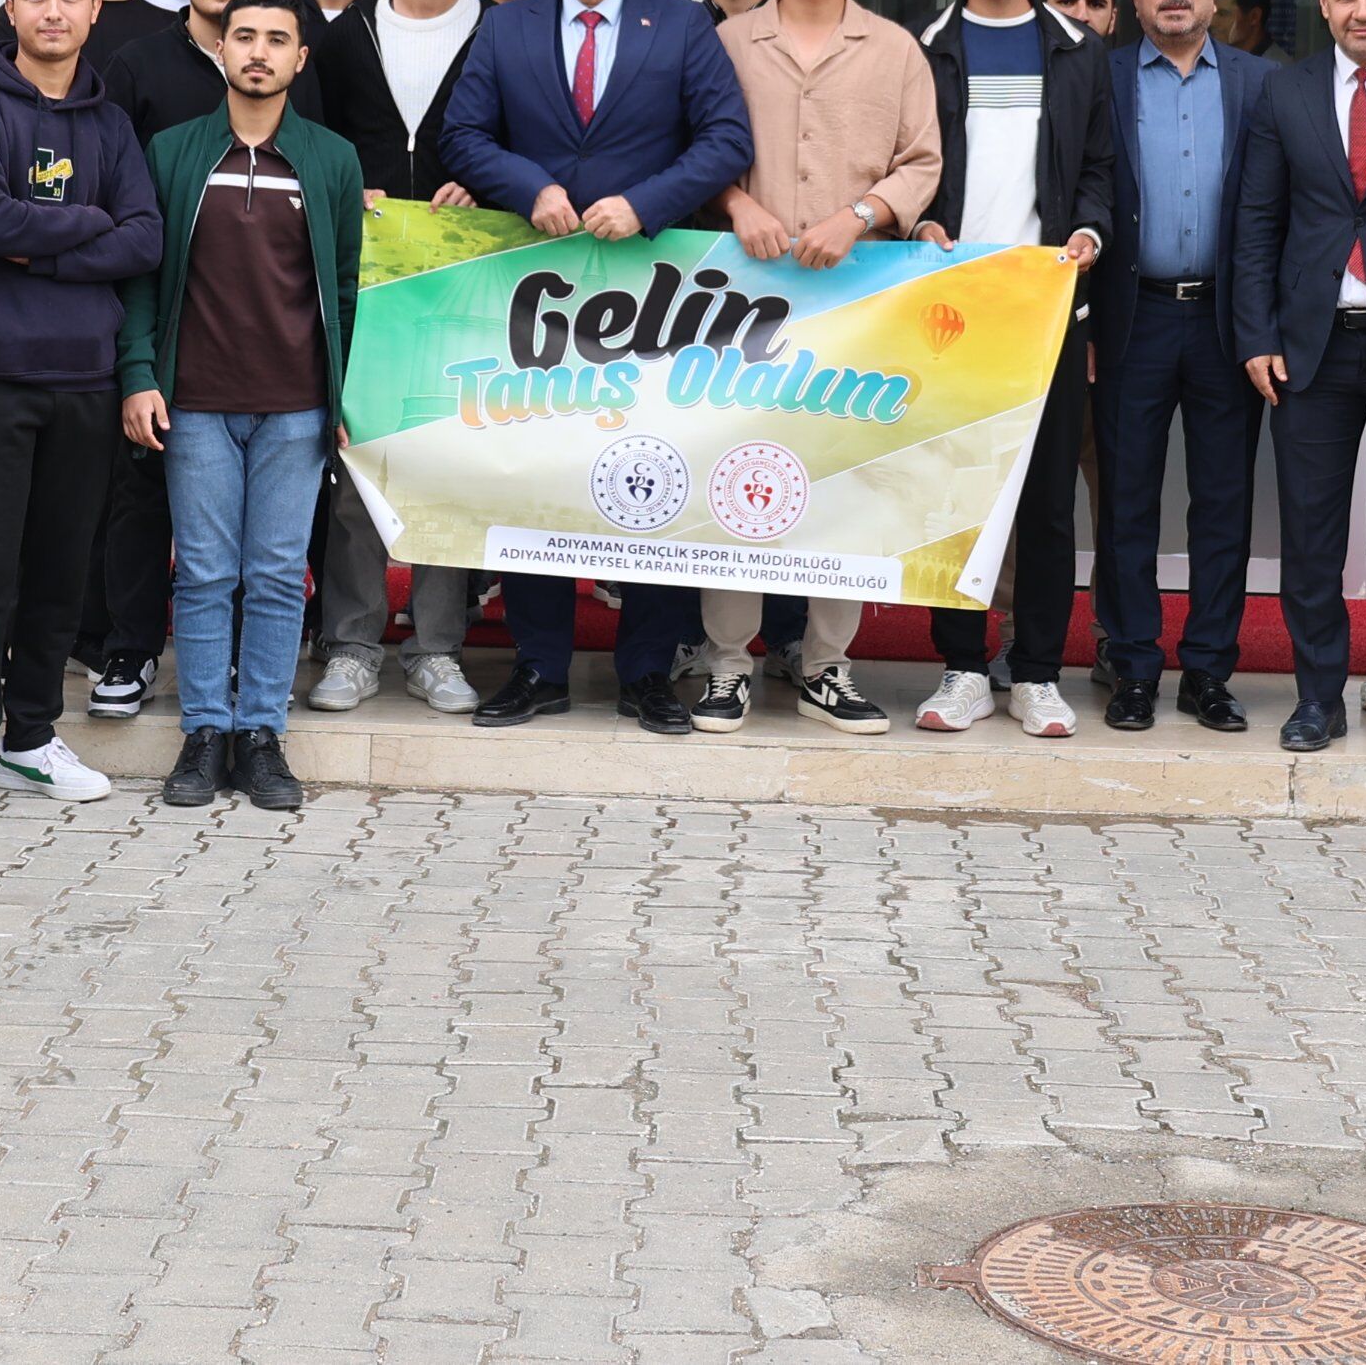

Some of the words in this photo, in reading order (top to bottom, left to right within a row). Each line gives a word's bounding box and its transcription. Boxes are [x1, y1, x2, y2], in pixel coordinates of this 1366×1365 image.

[509, 261, 791, 371] Gelin
[444, 357, 641, 429] Tanış
[664, 344, 910, 424] Olalım
[499, 548, 576, 564] ADIYAMAN
[579, 554, 630, 569] VEYSEL
[634, 559, 688, 574] KARANİ
[692, 564, 736, 577] ERKEK
[739, 568, 790, 582] YURDU
[793, 571, 888, 590] MÜDÜRLÜĞÜ
[546, 537, 624, 553] ADIYAMAN
[627, 543, 688, 559] GENÇLİK
[691, 549, 729, 562] SPOR
[732, 550, 744, 563] İL
[747, 552, 841, 571] MÜDÜRLÜĞÜ
